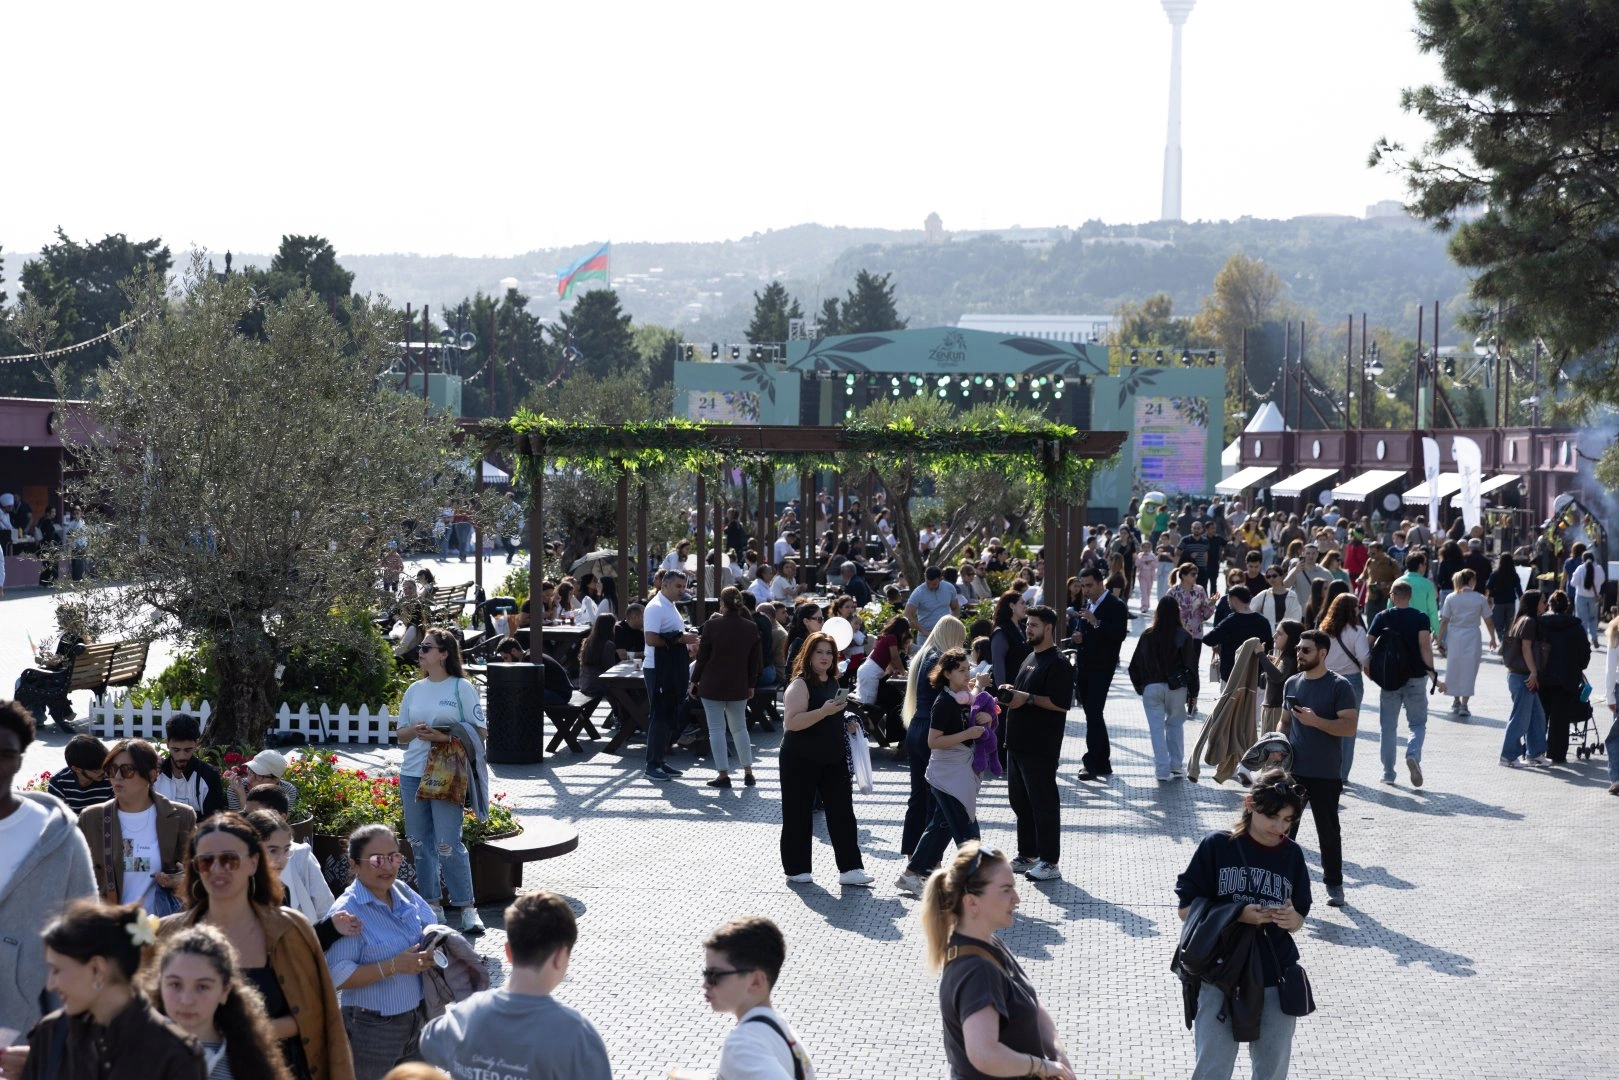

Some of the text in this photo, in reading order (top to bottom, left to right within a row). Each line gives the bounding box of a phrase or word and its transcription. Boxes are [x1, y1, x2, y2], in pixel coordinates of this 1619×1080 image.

[928, 348, 966, 362] Zeytun
[698, 397, 716, 409] 24
[1145, 403, 1162, 415] 24
[423, 773, 449, 787] Paris
